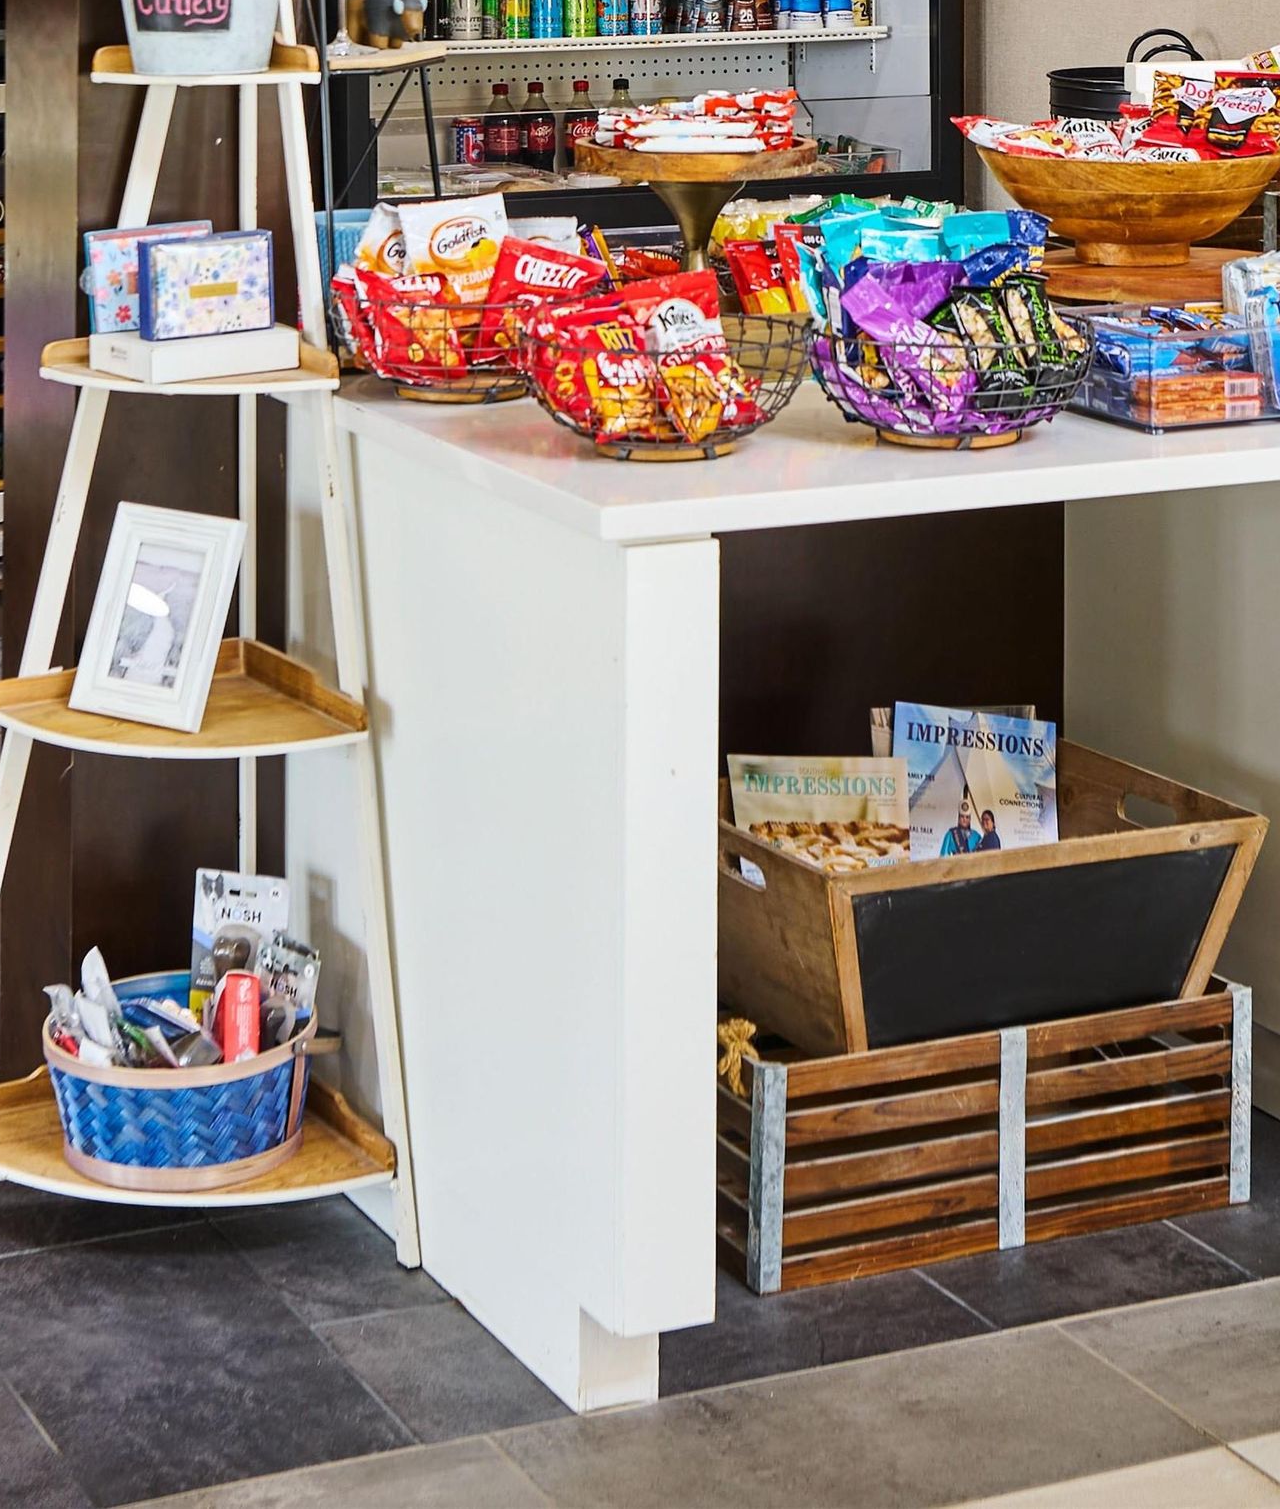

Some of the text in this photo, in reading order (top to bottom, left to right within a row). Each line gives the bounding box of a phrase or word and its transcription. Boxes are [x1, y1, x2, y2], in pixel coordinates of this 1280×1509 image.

[705, 11, 721, 25] 42
[740, 9, 755, 22] 26
[1214, 95, 1267, 114] Pretzels
[436, 223, 488, 254] Goldfish
[448, 266, 495, 285] CHEDDAR
[907, 721, 1045, 758] IMPRESSIONS
[743, 773, 897, 797] IMPRESSIONS
[999, 798, 1044, 809] CONNECTIONS
[1014, 792, 1044, 802] CULTURAL
